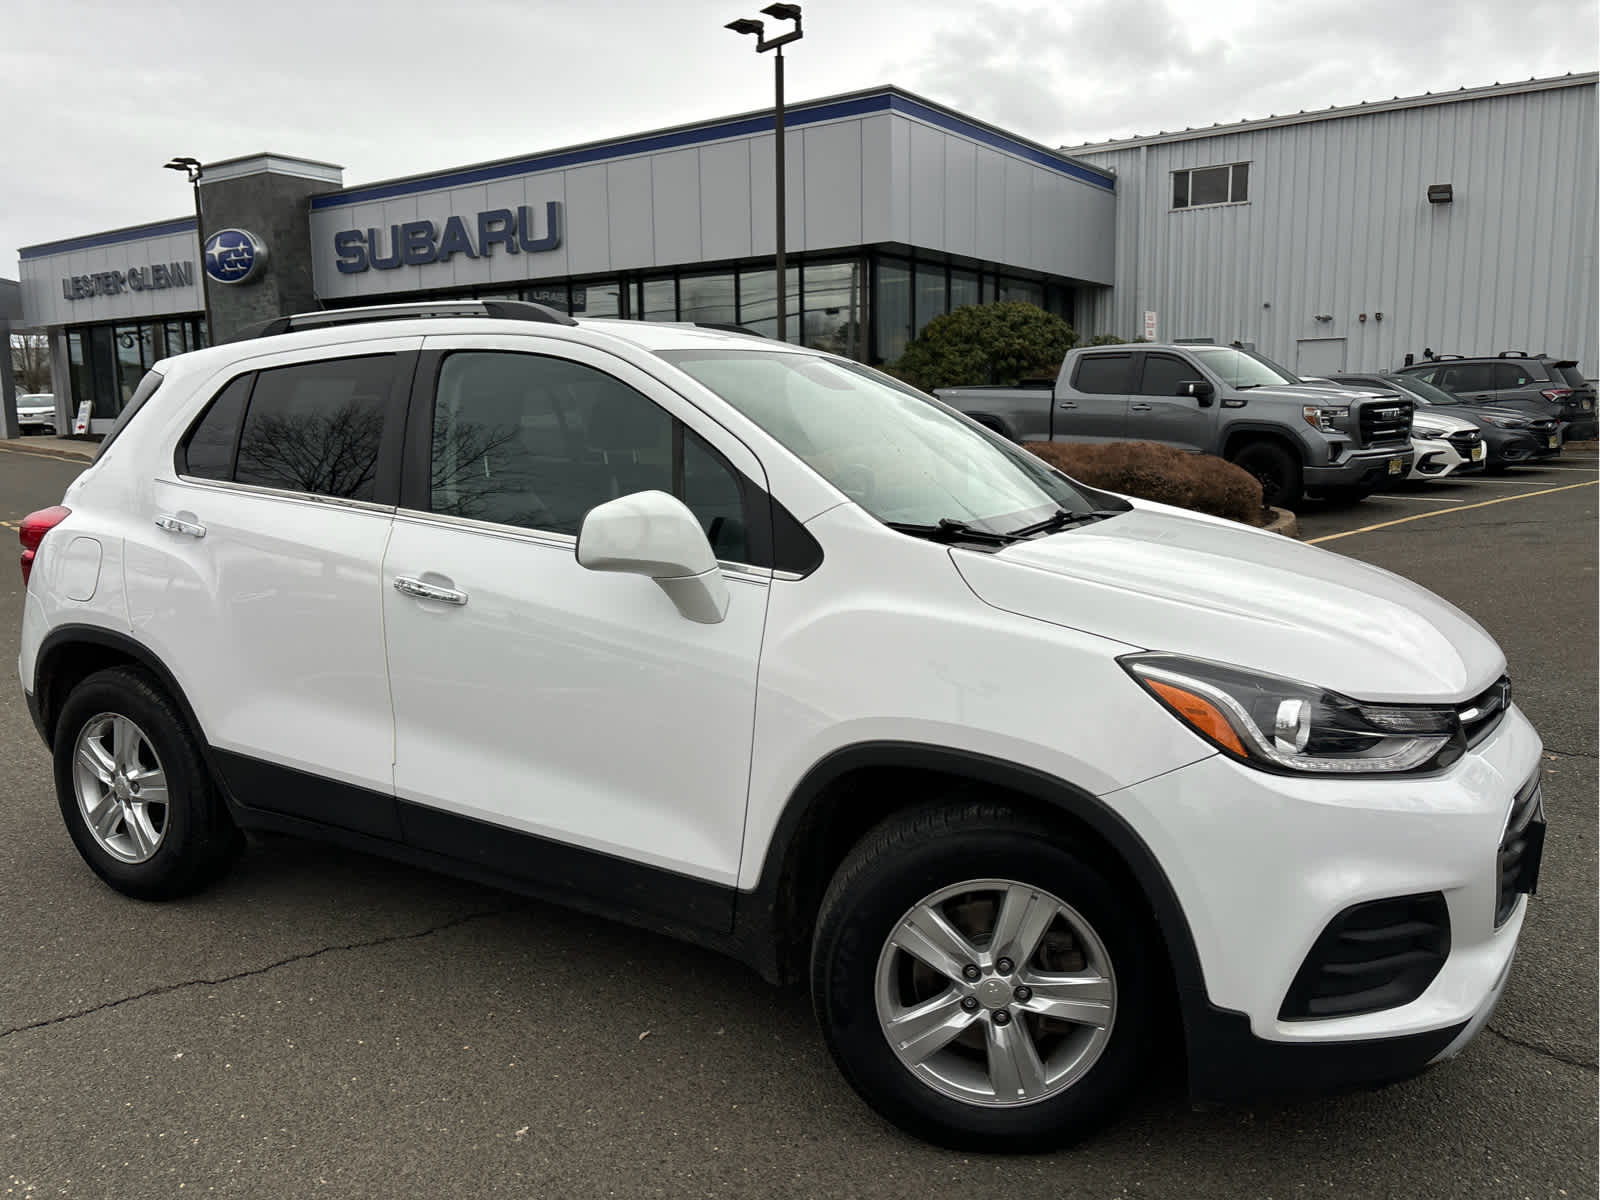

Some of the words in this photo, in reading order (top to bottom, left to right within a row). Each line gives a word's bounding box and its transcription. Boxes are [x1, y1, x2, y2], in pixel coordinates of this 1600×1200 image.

[334, 201, 562, 274] SUBARU
[62, 271, 128, 300] LESTER
[128, 261, 193, 291] GLENN
